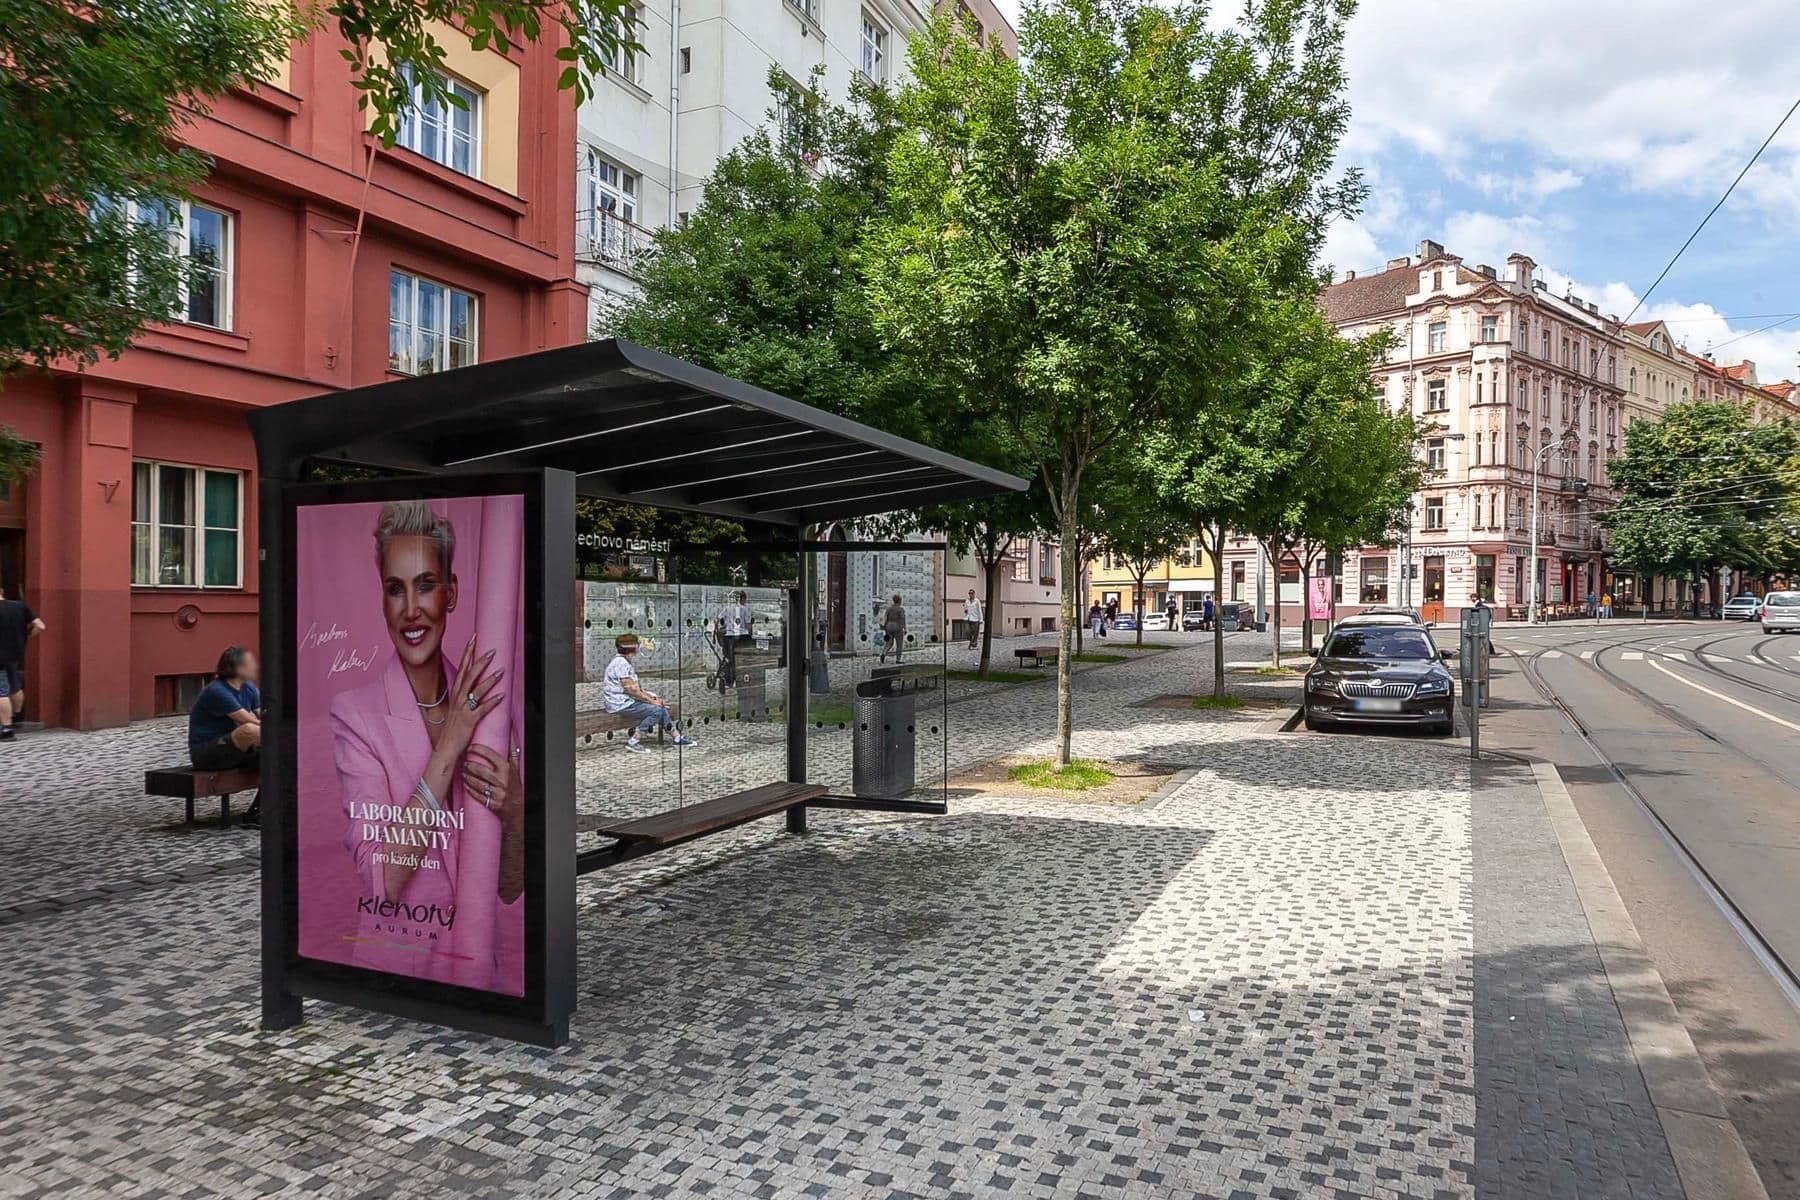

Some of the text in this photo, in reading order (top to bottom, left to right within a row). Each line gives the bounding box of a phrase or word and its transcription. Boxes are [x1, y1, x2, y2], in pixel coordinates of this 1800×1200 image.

[576, 532, 623, 549] echovo
[349, 801, 465, 830] LABORATORNÍ
[362, 823, 451, 850] DIAMANTY
[372, 851, 440, 870] pro každý den
[375, 923, 438, 940] AURUM
